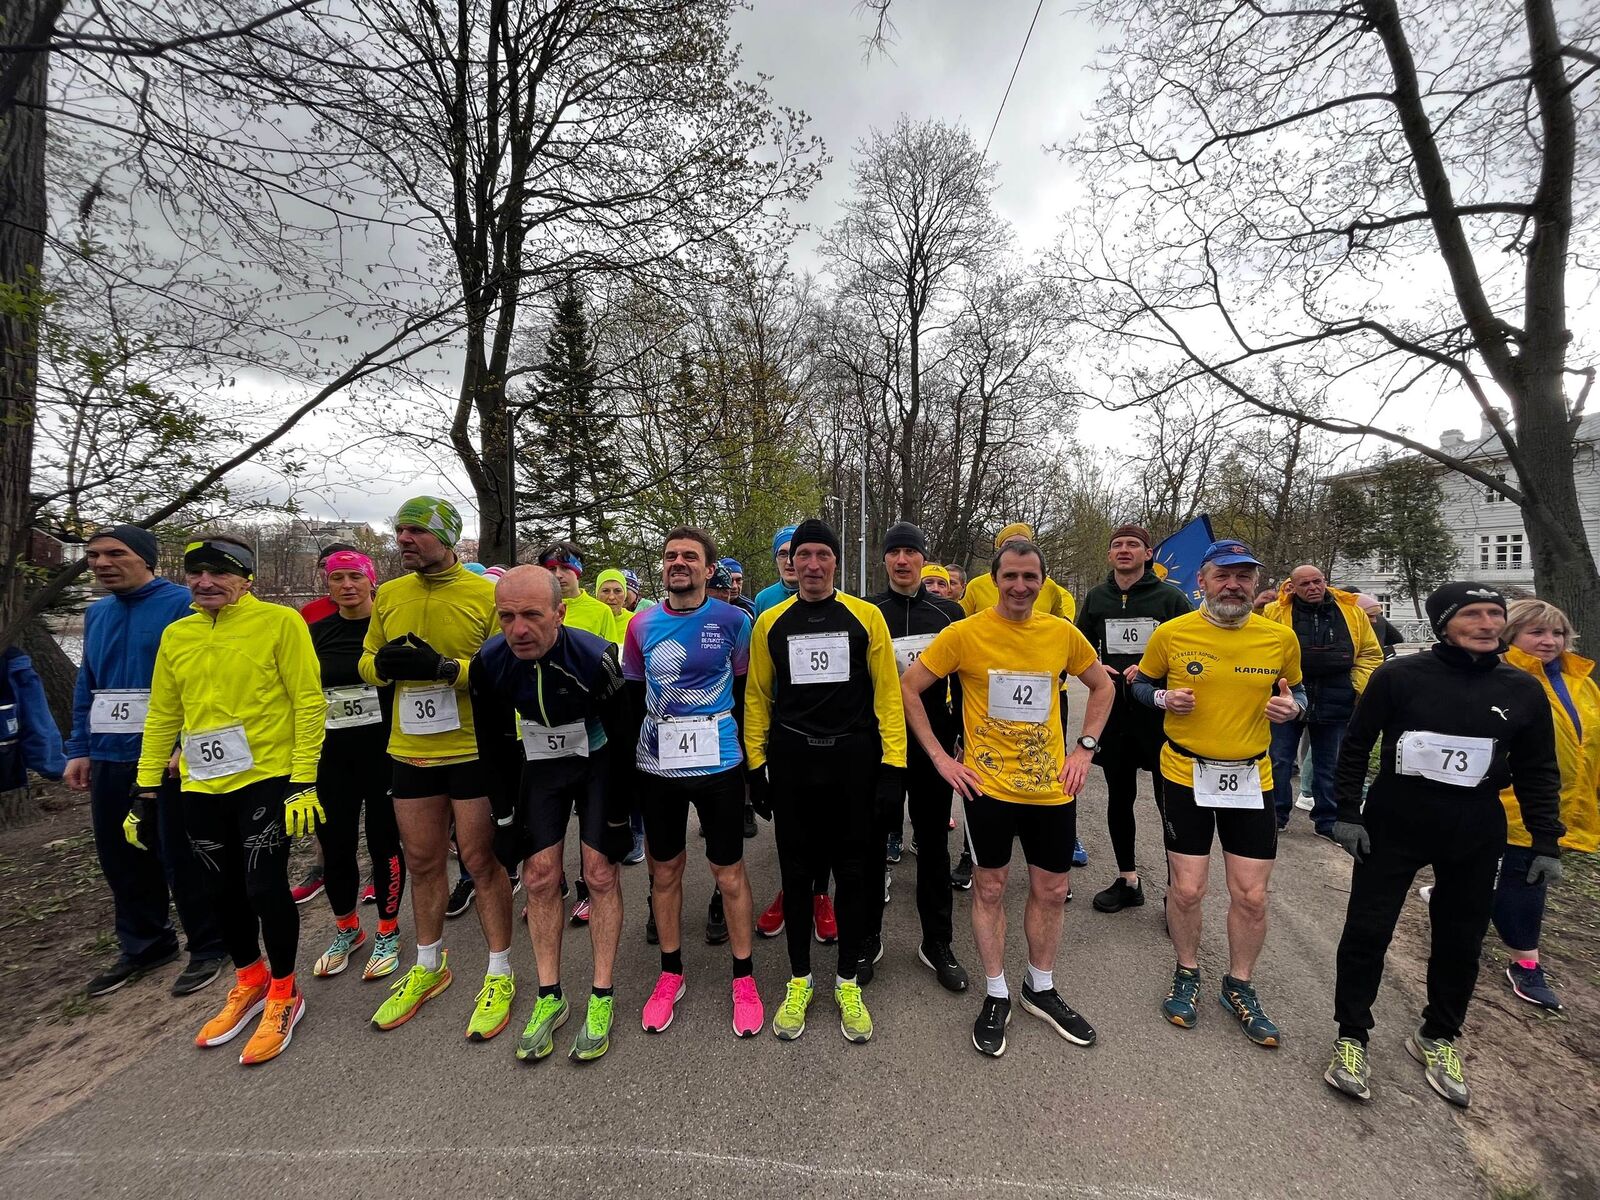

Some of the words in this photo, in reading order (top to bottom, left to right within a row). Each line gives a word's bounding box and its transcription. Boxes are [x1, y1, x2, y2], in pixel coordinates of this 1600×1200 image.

[1122, 627, 1138, 642] 46
[810, 650, 829, 671] 59
[1012, 684, 1033, 705] 42
[111, 702, 129, 721] 45
[343, 699, 363, 717] 55
[414, 698, 436, 720] 36
[200, 740, 225, 762] 56
[547, 735, 566, 750] 57
[679, 732, 697, 753] 41
[1441, 749, 1468, 772] 73
[1218, 773, 1238, 791] 58
